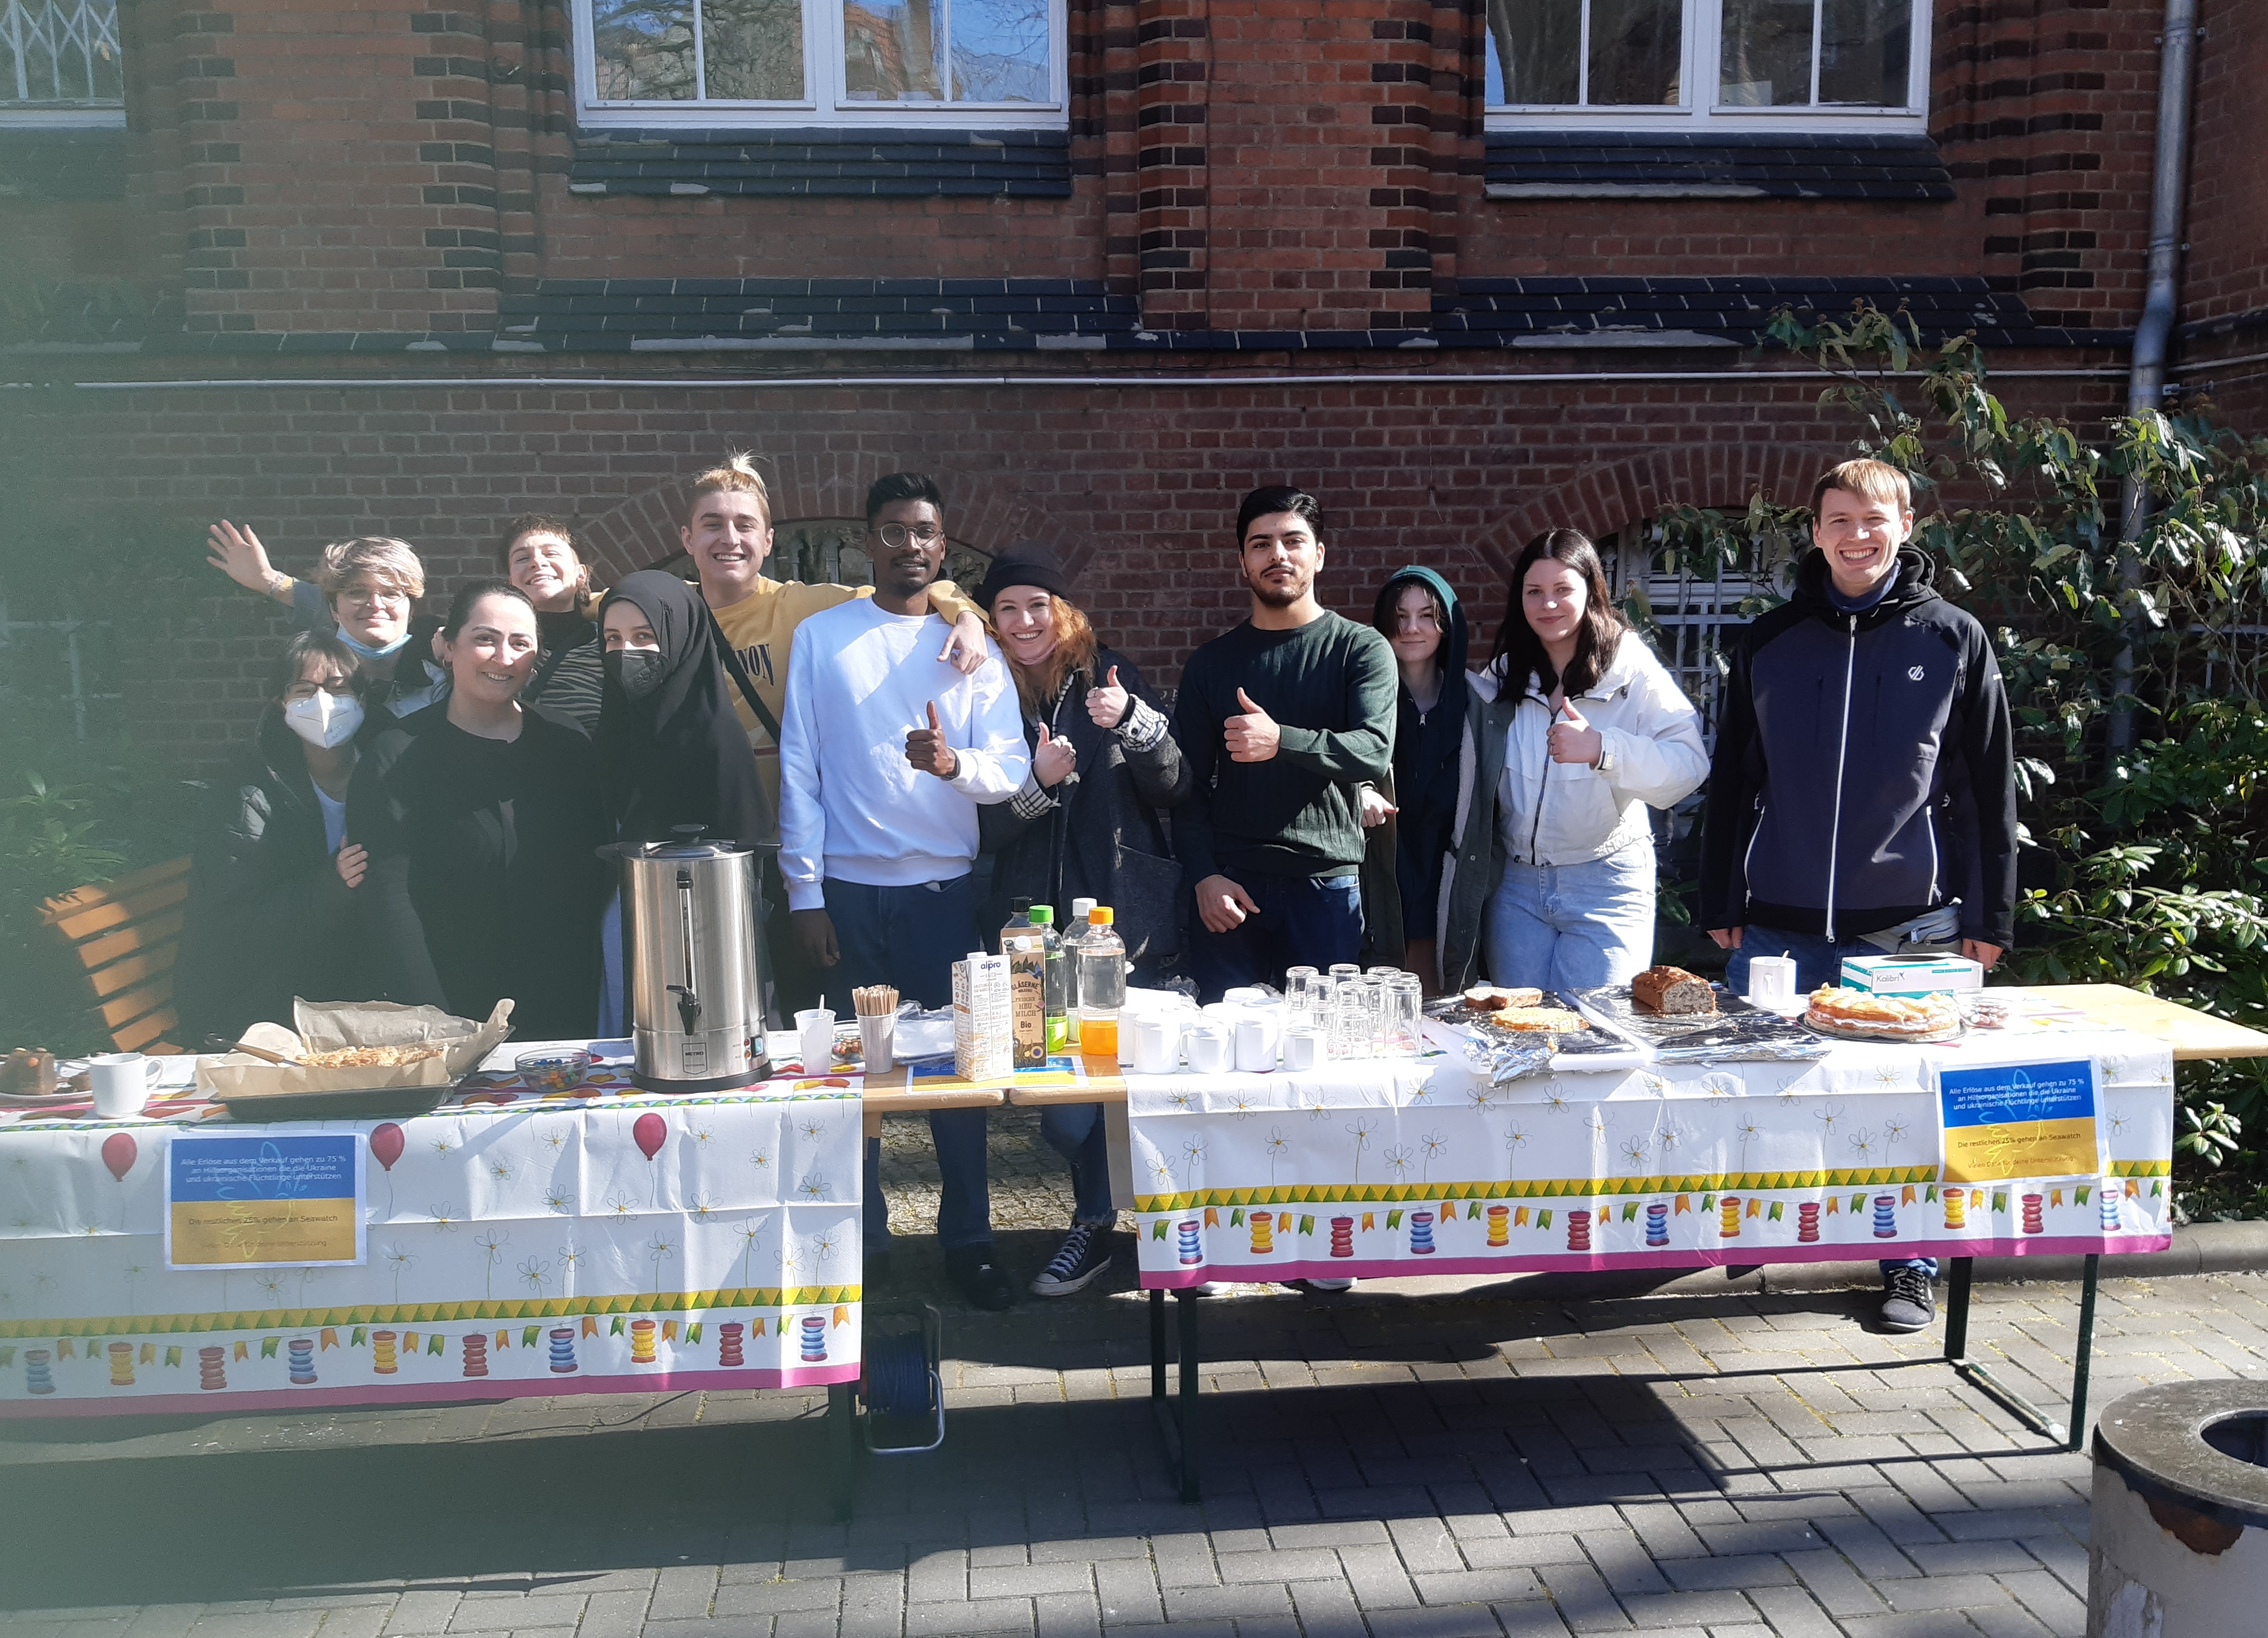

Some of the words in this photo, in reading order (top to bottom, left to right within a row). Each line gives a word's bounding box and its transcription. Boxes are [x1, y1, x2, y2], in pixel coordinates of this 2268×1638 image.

[980, 961, 1001, 970] alpro
[1011, 981, 1039, 990] GLÄSERNE
[2038, 1080, 2057, 1089] gehen
[1967, 1091, 2027, 1100] Hilfsorganisationen
[290, 1156, 314, 1164] gehen
[293, 1172, 342, 1180] unterstützen
